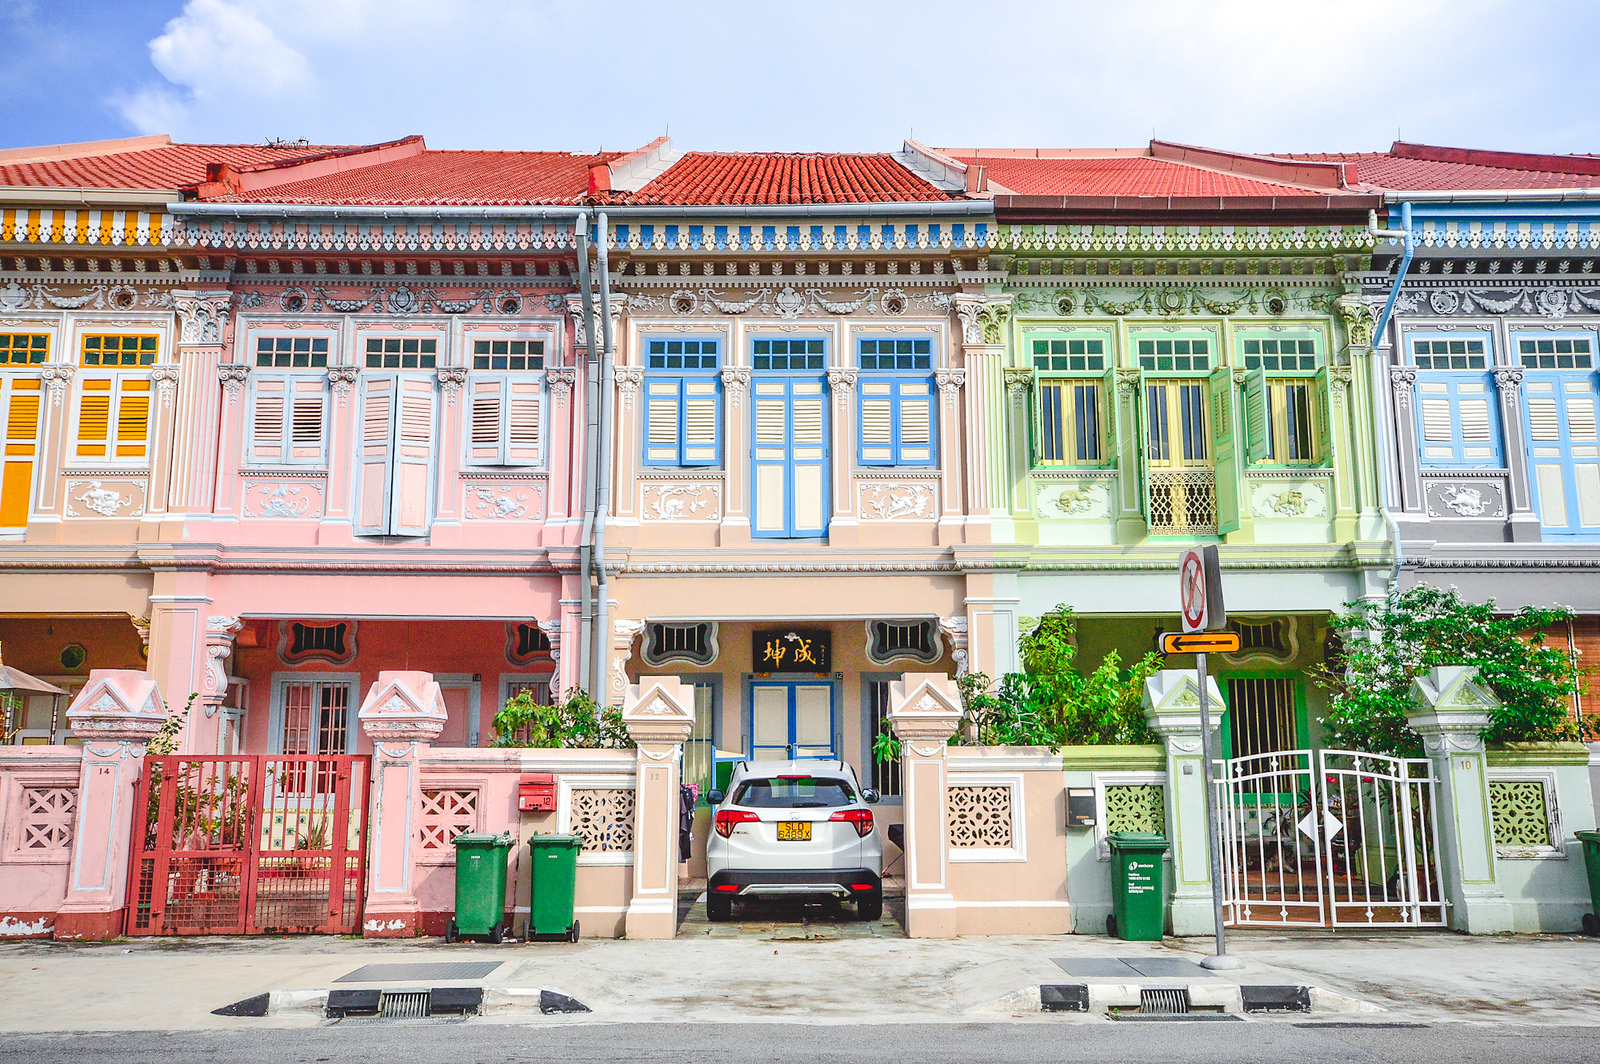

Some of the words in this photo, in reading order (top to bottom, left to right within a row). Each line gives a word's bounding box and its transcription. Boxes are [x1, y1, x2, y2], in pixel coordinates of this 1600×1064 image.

[1461, 760, 1471, 770] 10
[99, 767, 110, 775] 14
[543, 797, 551, 805] 12
